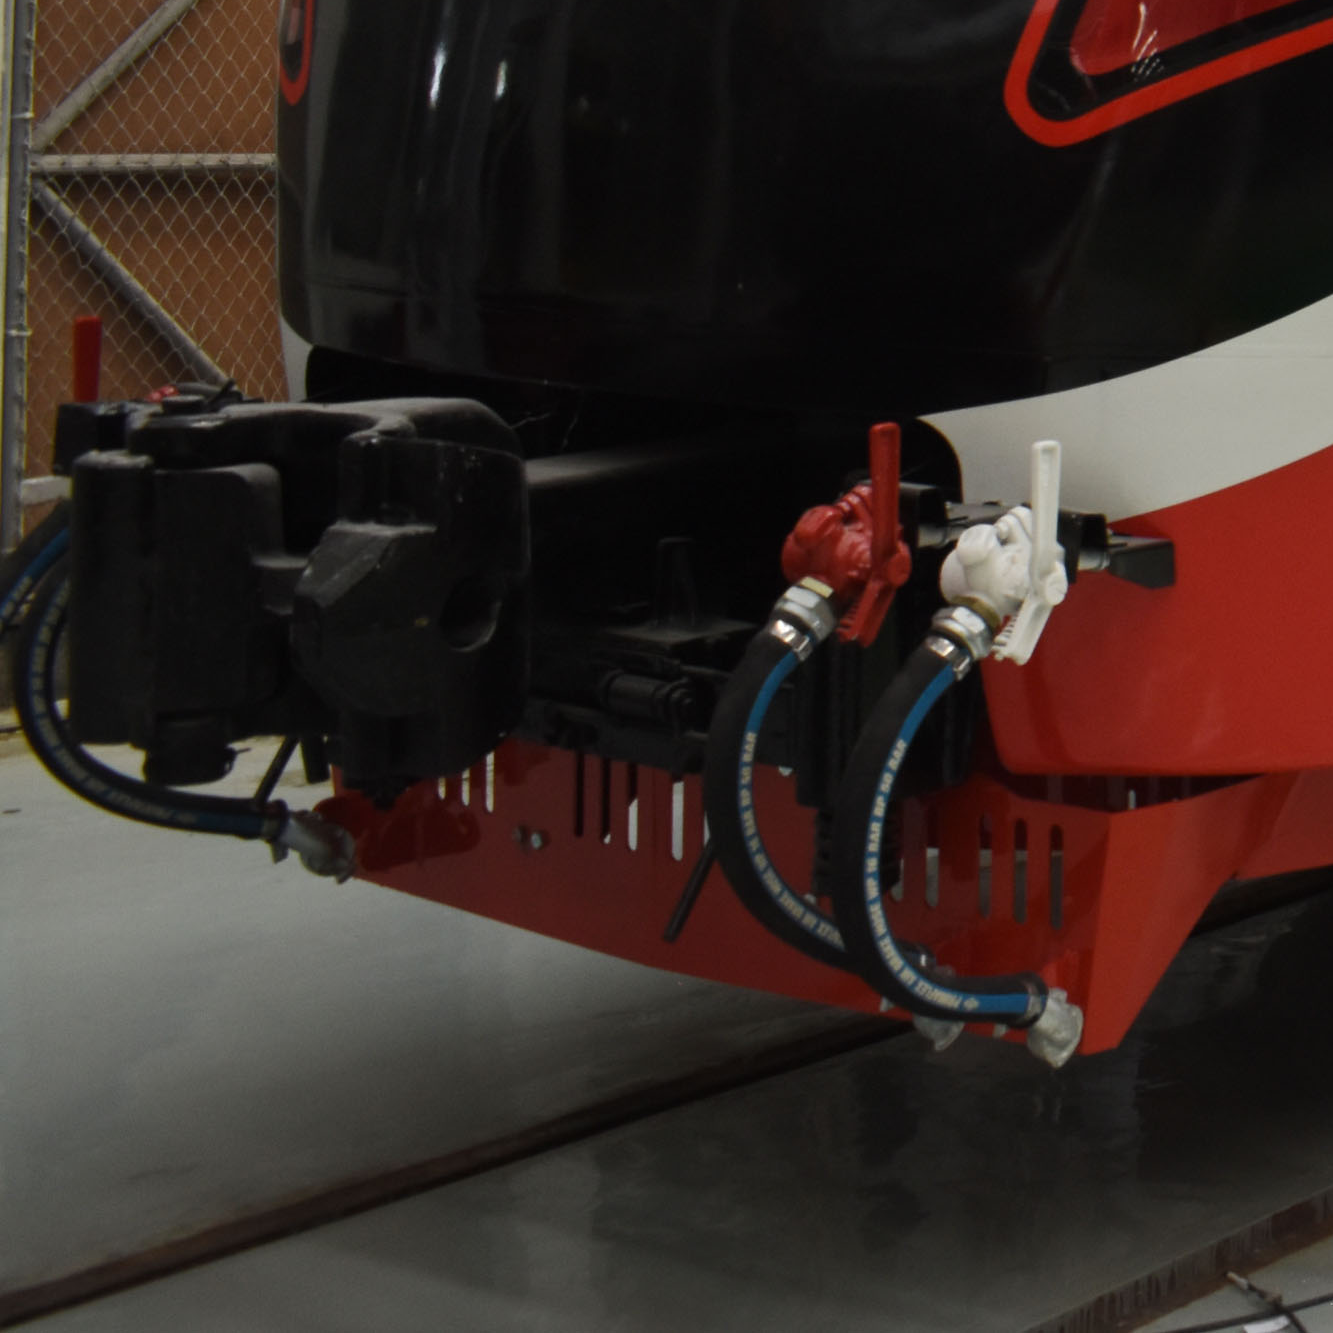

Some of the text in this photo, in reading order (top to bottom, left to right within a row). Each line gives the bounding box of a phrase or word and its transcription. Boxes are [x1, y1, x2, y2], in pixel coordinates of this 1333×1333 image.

[743, 731, 757, 762] BAR
[868, 822, 881, 852] BAR
[888, 739, 907, 771] BAR
